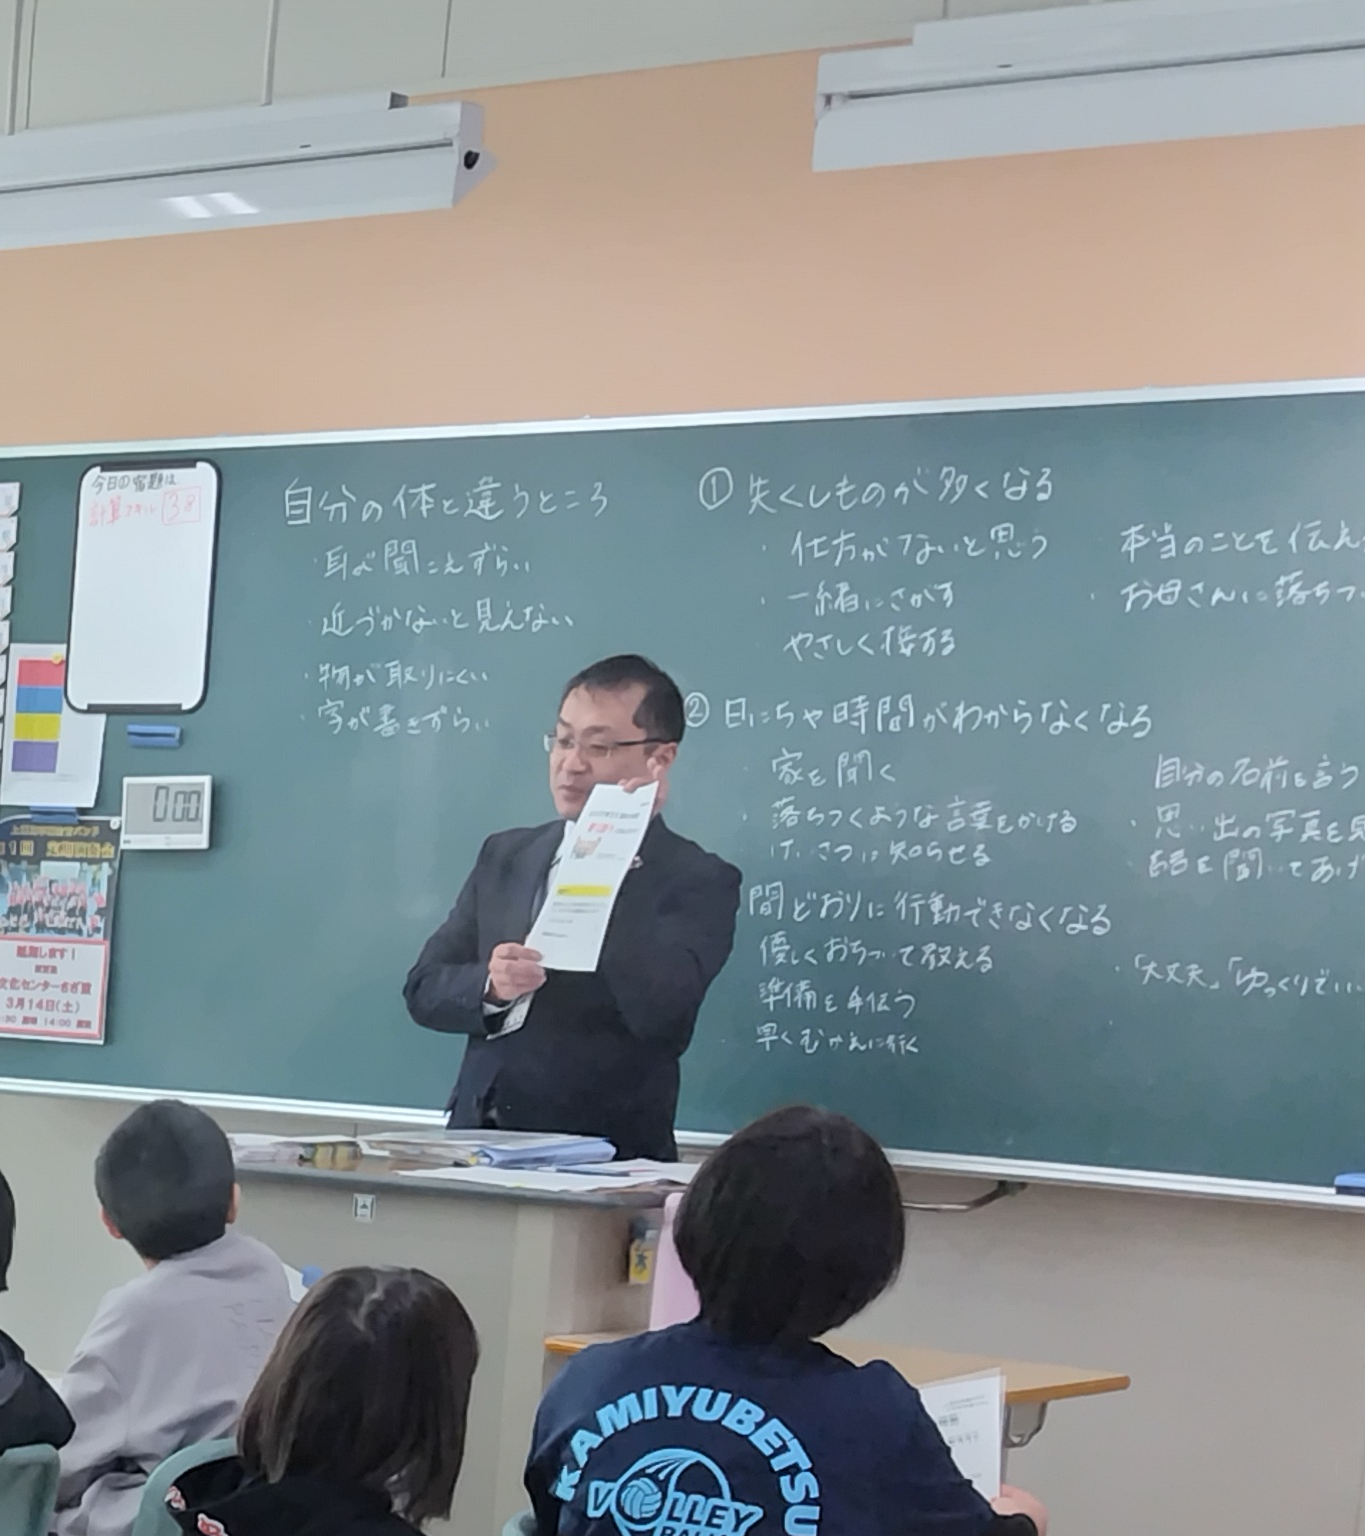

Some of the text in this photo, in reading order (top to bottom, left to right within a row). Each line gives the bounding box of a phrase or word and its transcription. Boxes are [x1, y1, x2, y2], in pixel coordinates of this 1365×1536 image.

[284, 476, 608, 525] 自分の体と違うところ
[323, 539, 531, 581] 耳が聞こえずらい
[790, 522, 1048, 567] 仕方がないと思う
[1120, 519, 1365, 564] 本当のことを伝え
[786, 580, 955, 617] 一緒にさがす
[1120, 569, 1365, 613] お母さんに落ちつ
[321, 597, 575, 637] 近づかないと見えない
[783, 624, 956, 662] やさしく接する
[318, 659, 489, 691] 物が取りにくい
[1154, 753, 1360, 794] 自分の名前を言う
[757, 975, 917, 1018] 準備を手伝う
